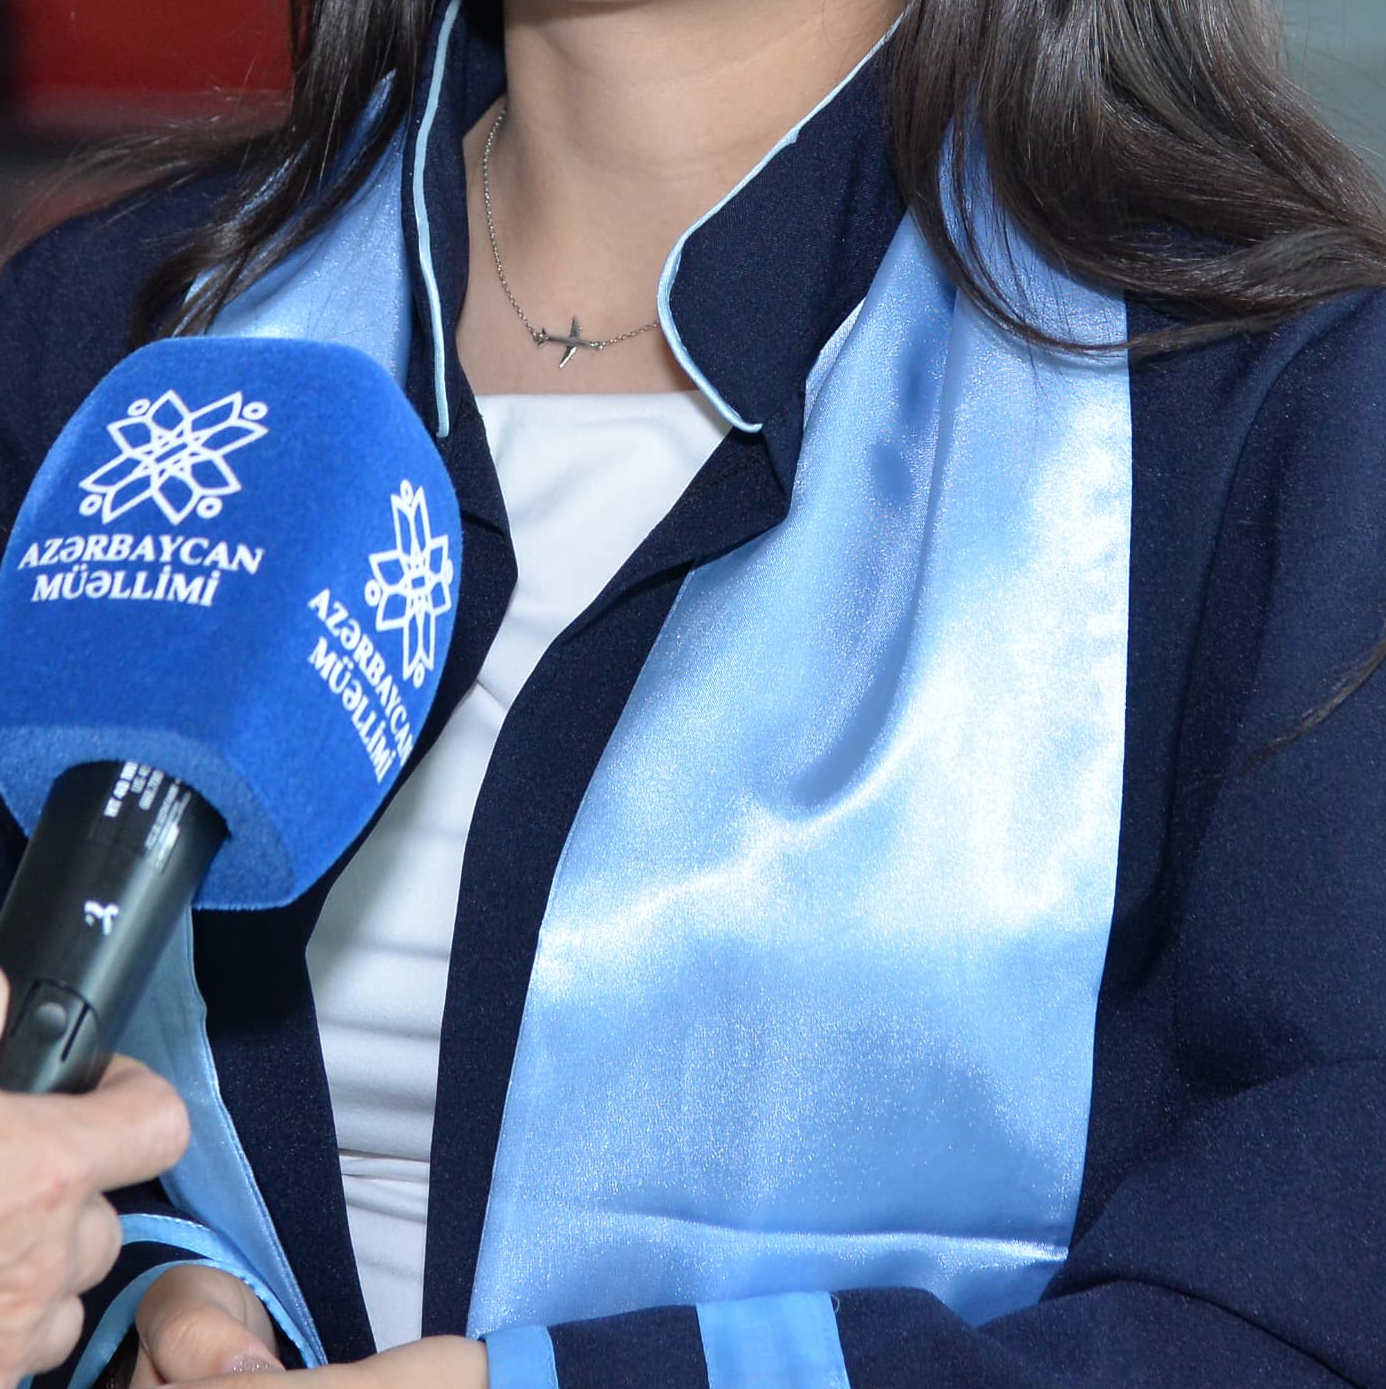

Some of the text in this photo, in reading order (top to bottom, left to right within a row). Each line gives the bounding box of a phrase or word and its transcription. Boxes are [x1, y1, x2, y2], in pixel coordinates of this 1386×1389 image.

[16, 533, 265, 576] AZƏRBAYCAN
[31, 563, 222, 608] MÜƏLLİMİ
[307, 635, 398, 785] MÜƏLLİMİ
